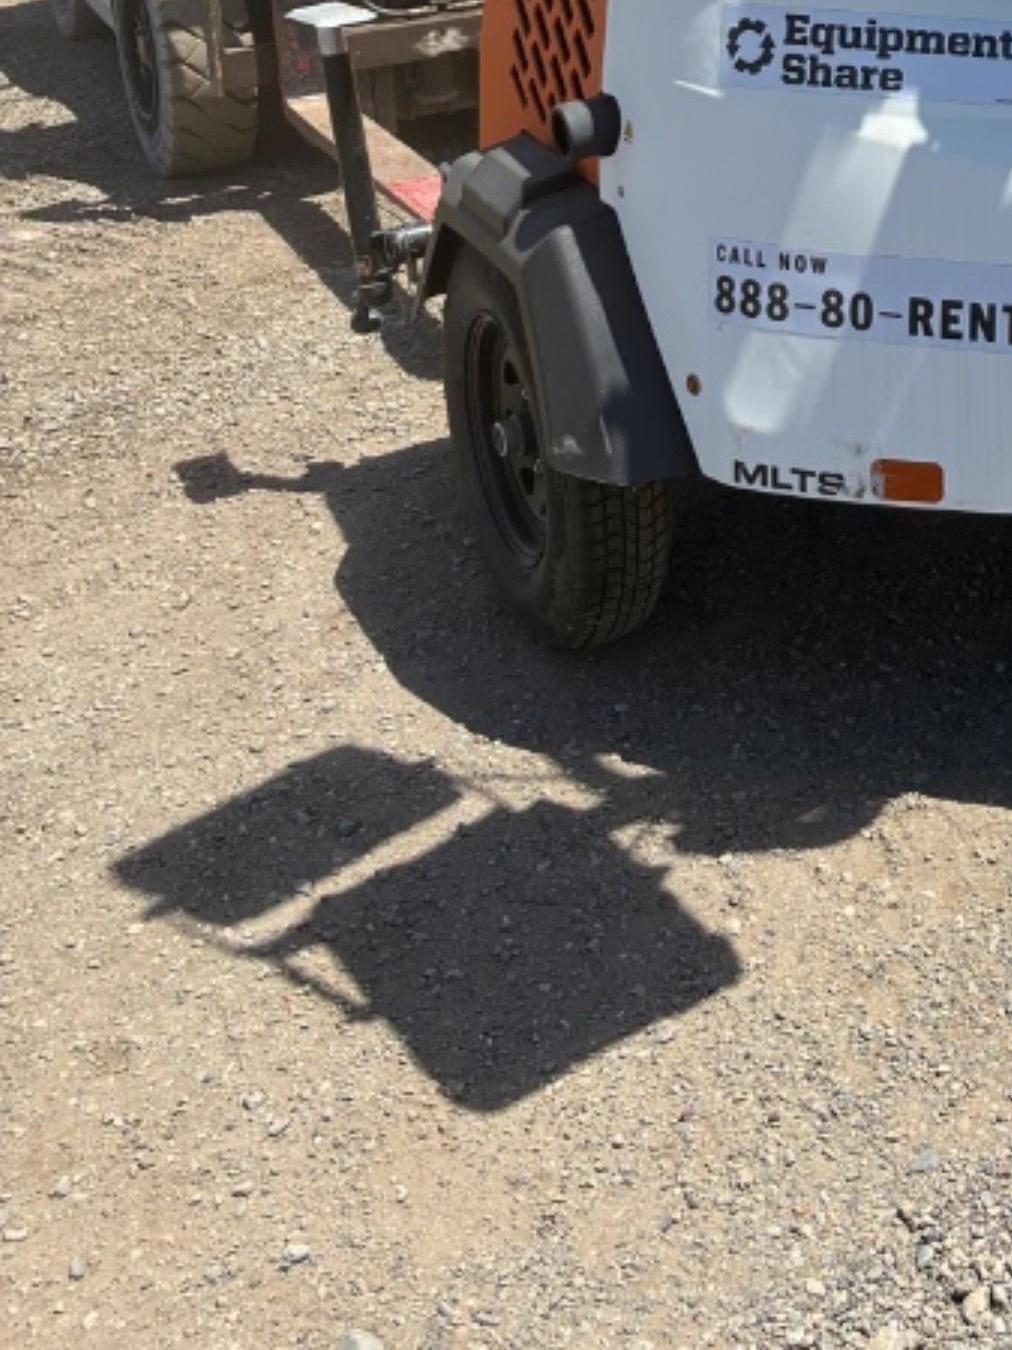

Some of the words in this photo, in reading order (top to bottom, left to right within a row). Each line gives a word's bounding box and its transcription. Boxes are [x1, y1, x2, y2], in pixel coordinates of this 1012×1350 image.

[781, 53, 904, 91] Share
[716, 243, 767, 268] CALL
[779, 252, 828, 274] NOW
[734, 458, 845, 496] MLTS
